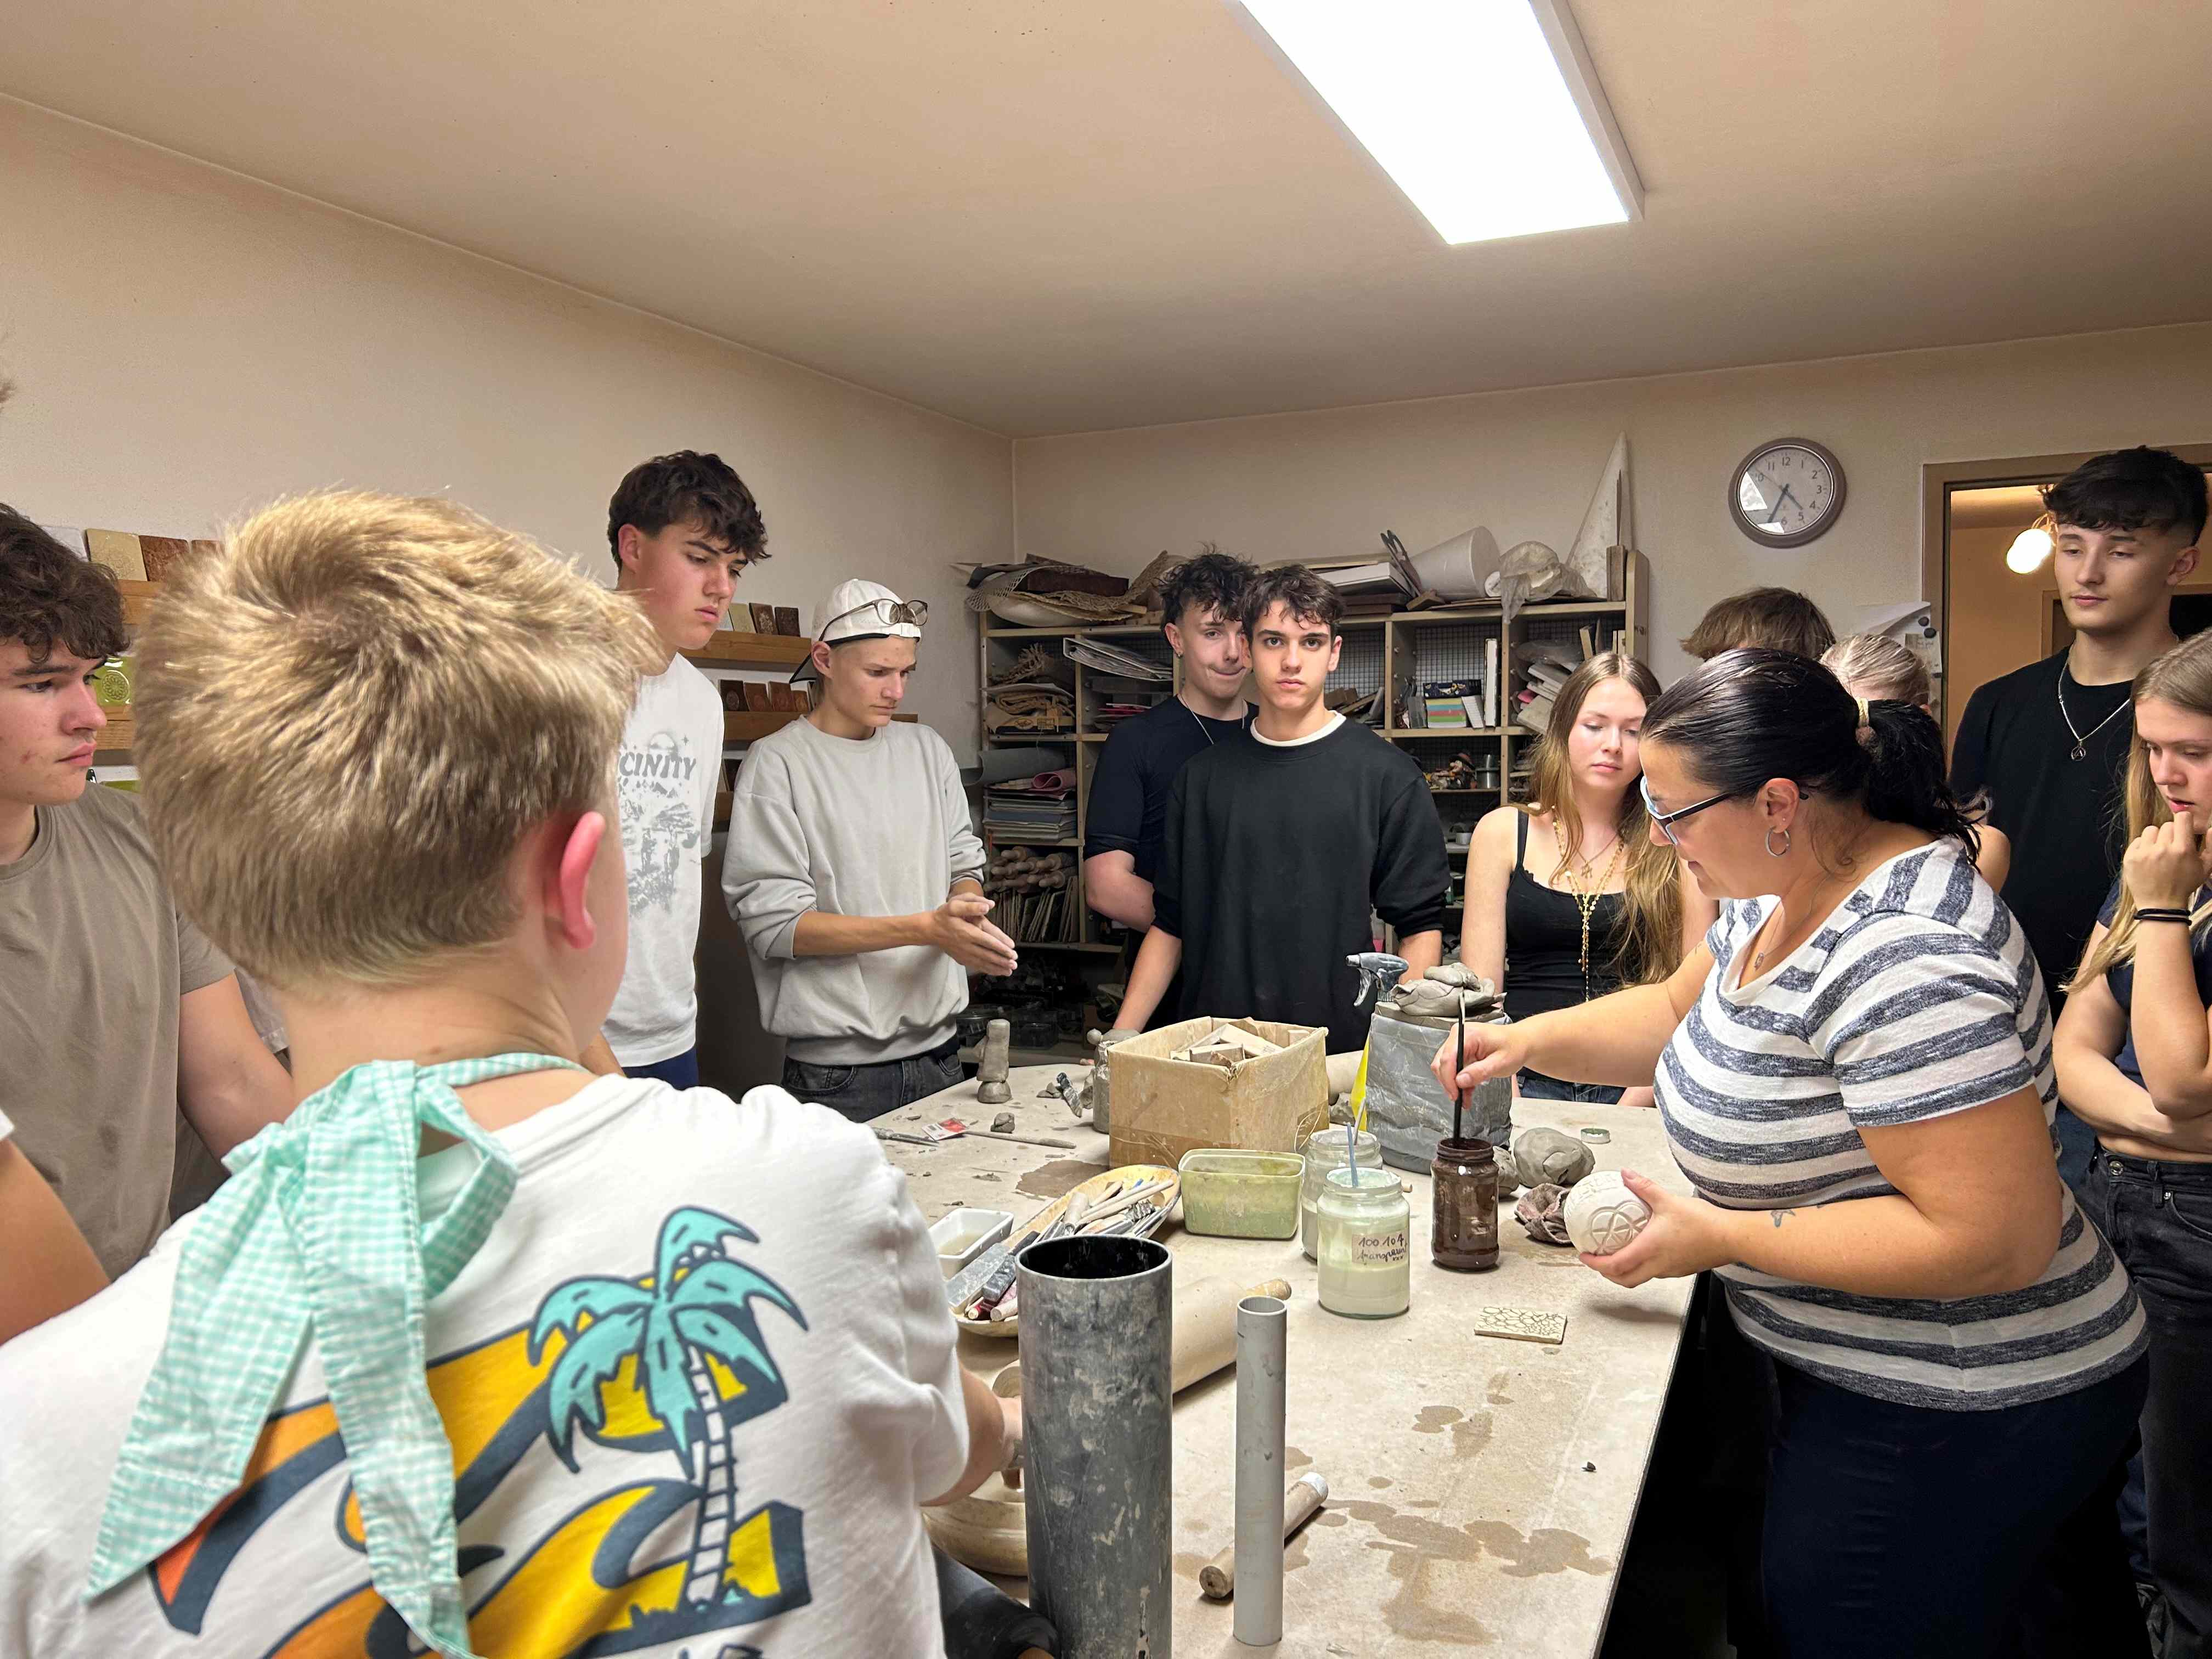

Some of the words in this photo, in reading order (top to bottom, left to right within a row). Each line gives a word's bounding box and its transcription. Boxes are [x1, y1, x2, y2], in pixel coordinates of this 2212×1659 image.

[1768, 461, 1774, 470] 11
[1782, 456, 1791, 466] 12
[1812, 470, 1817, 479] 2
[1817, 485, 1822, 494] 3
[1809, 500, 1815, 509] 4
[1781, 516, 1787, 525] 6
[1798, 512, 1804, 521] 5
[619, 752, 696, 780] CINITY
